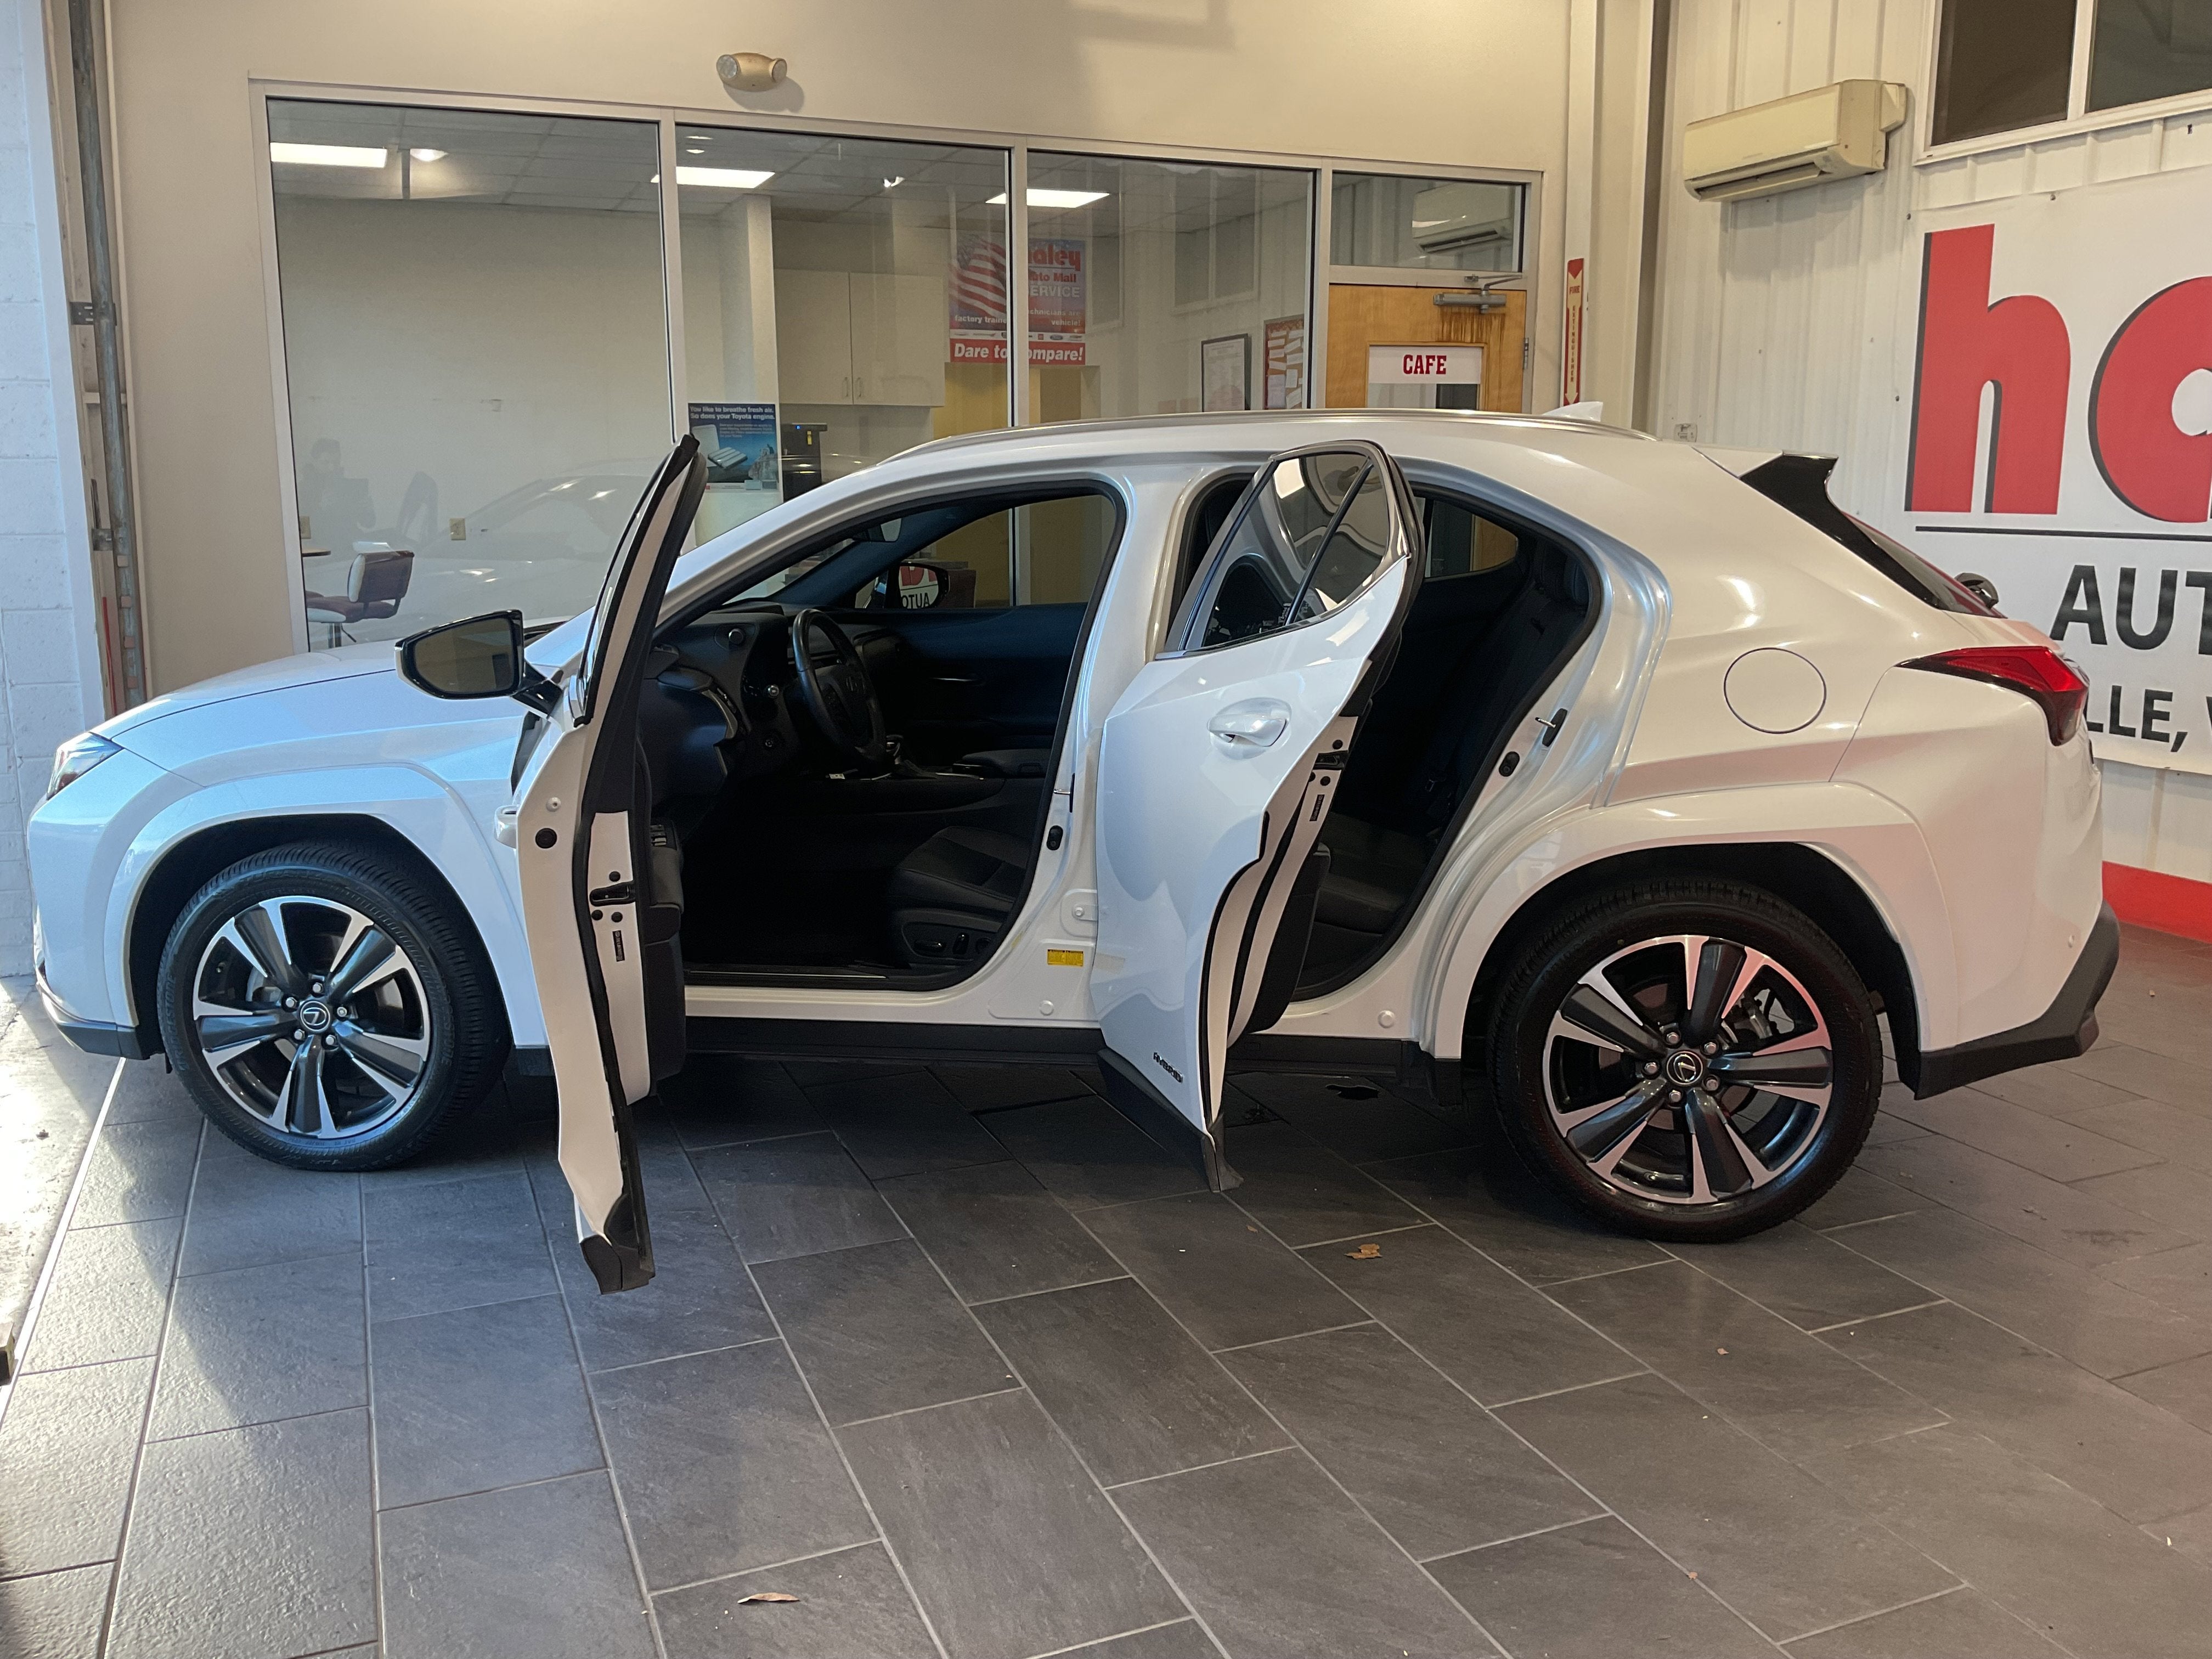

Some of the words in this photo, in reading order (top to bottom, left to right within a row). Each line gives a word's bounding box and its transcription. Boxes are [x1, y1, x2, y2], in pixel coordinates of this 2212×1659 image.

[1029, 245, 1081, 272] aley
[1053, 273, 1076, 283] Mall
[1029, 285, 1081, 298] ERVICE
[1570, 285, 1580, 295] FIRE
[955, 315, 983, 324] factory
[955, 343, 989, 358] Dare
[994, 345, 1007, 359] to
[1403, 354, 1447, 374] CAFE
[1153, 1052, 1183, 1083] HYBRID
